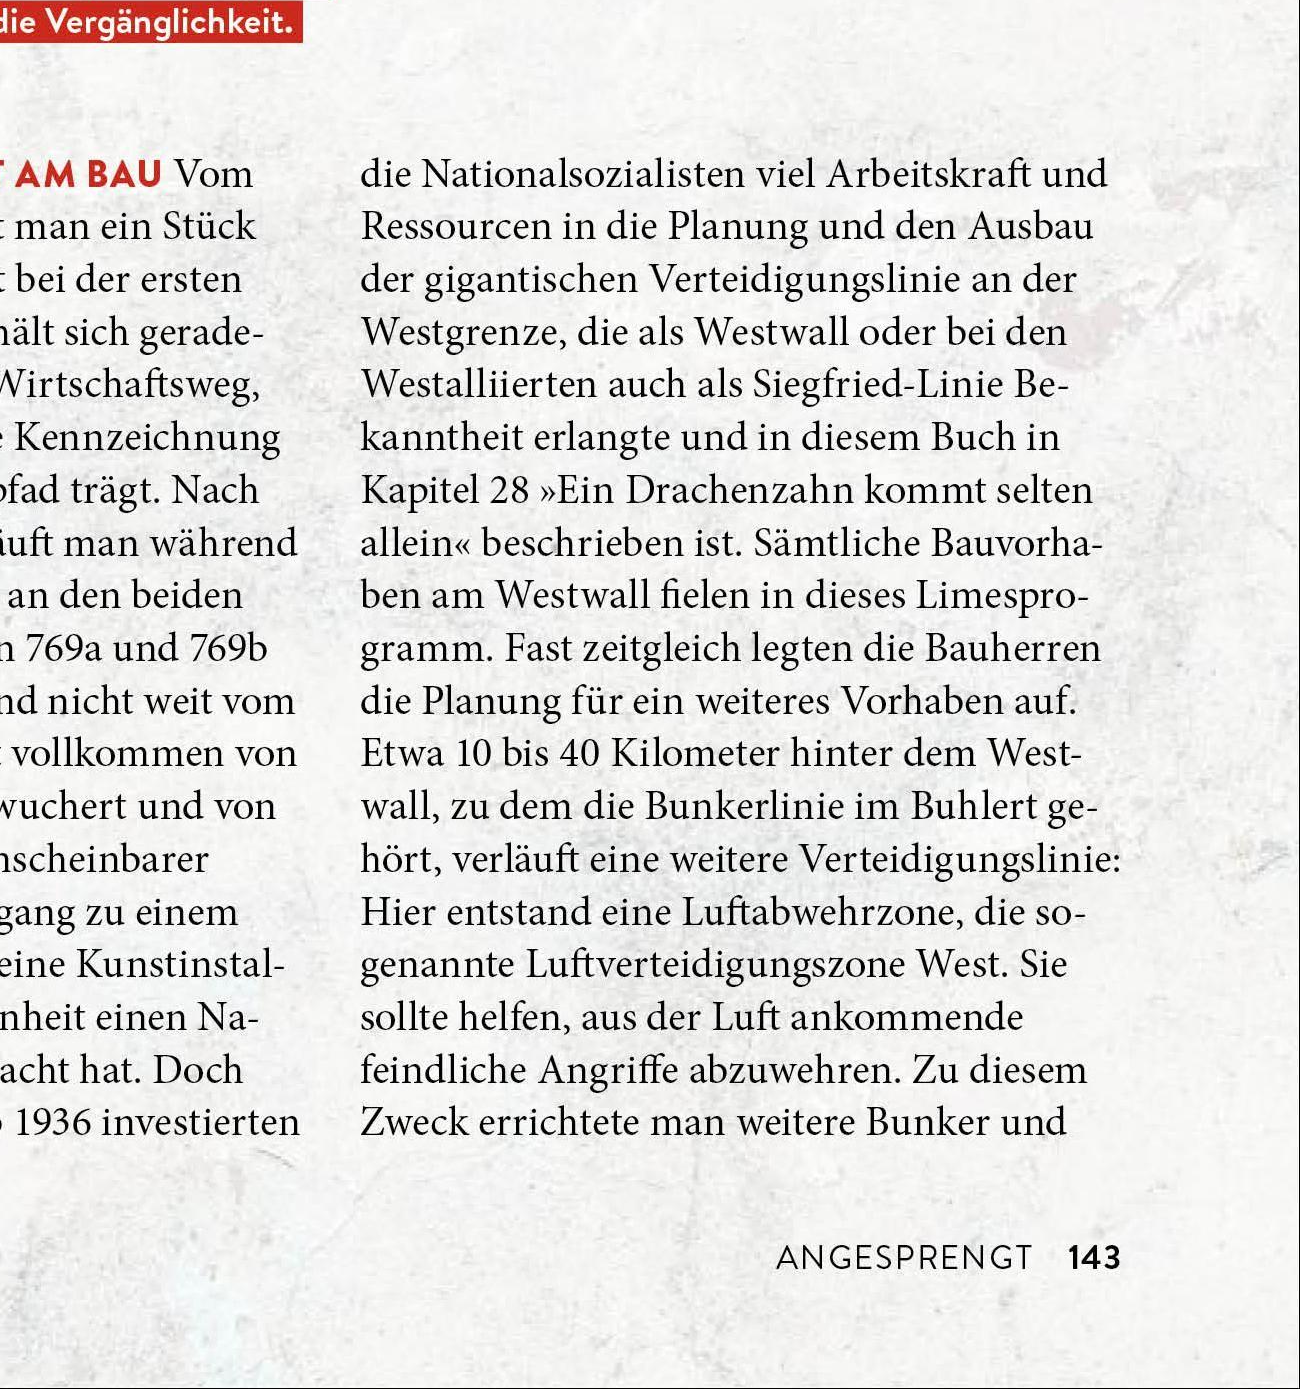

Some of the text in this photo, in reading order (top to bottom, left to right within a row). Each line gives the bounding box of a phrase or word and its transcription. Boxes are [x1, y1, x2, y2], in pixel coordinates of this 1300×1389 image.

[45, 8, 292, 41] Vergänglichkeit.
[15, 160, 74, 187] AM
[89, 160, 160, 187] BAU
[174, 159, 253, 187] Vom
[361, 157, 1107, 187] die Nationalsozialisten viel Arbeitskraft und
[361, 367, 1068, 407] Westalliierten auch als Siegfried-Linie Be-
[15, 420, 280, 460] Kennzeichnung
[27, 634, 102, 661] 769a
[113, 631, 179, 661] und
[191, 631, 267, 661] 769b
[361, 736, 1081, 766] Etwa 10 bis 40 Kilometer hinter dem West-
[361, 842, 1119, 882] hört, verläuft eine weitere Verteidigungslinie:
[77, 947, 284, 977] Kunstinstal-
[361, 947, 1066, 987] genannte Luftverteidigungszone West. Sie
[776, 1245, 1119, 1269] ANGESPRENGT 143
